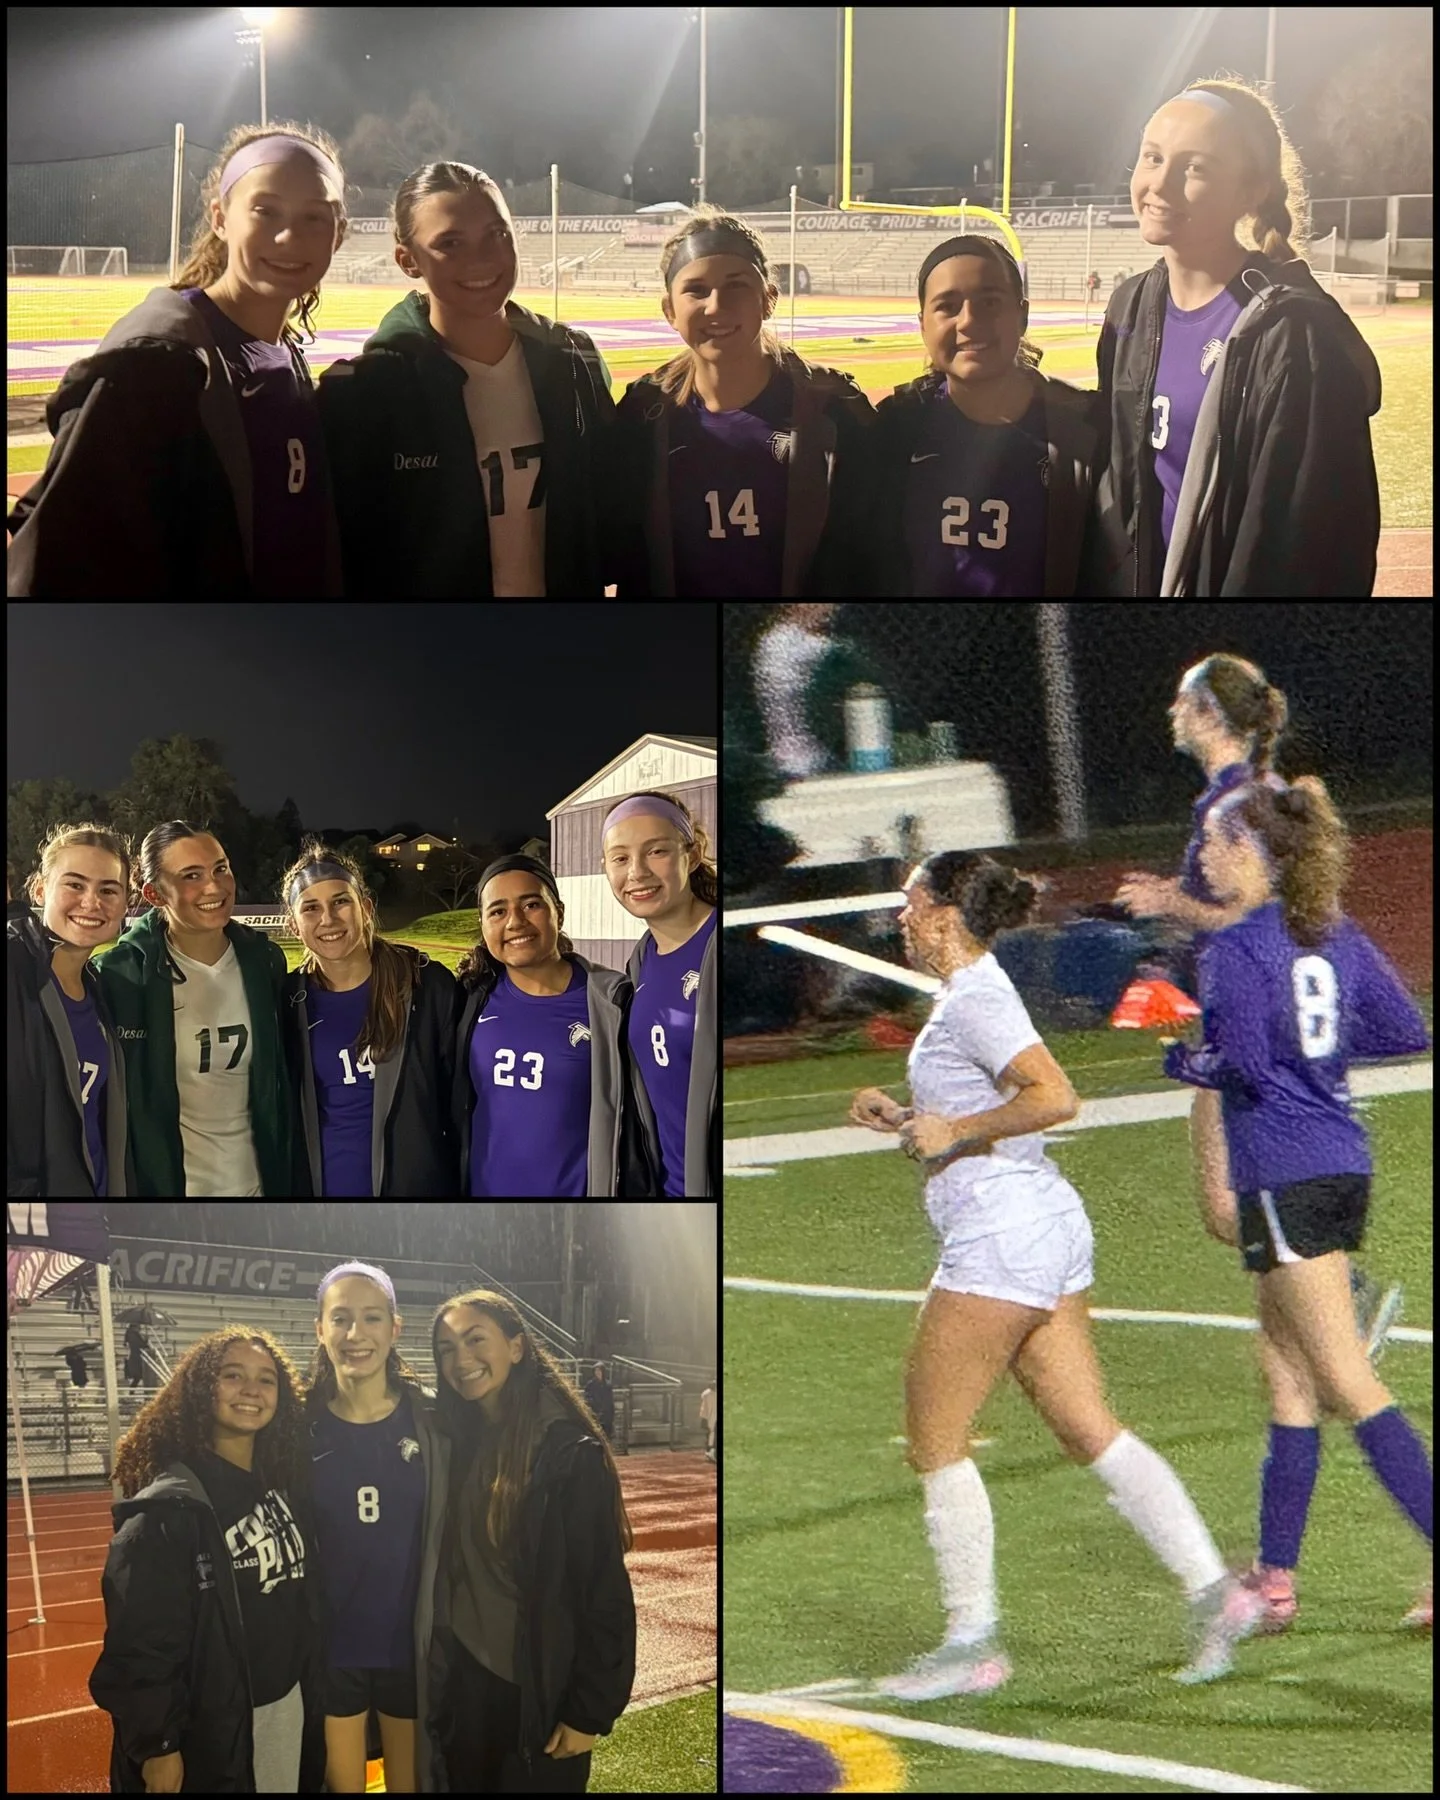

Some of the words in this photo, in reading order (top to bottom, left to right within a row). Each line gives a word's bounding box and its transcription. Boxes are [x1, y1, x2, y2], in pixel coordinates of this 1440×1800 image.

[360, 221, 396, 233] COLLE
[514, 219, 540, 232] OME
[558, 219, 581, 233] THE
[796, 215, 870, 230] COURAGE
[880, 214, 926, 229] PRIDE
[937, 215, 997, 228] HONO
[1015, 210, 1110, 227] SACRIFICE
[287, 437, 306, 494] 8
[393, 452, 439, 471] Desai
[480, 441, 547, 517] 17
[704, 488, 761, 539] 14
[941, 496, 1010, 550] 23
[244, 916, 286, 925] SACRI
[1291, 954, 1340, 1059] 8
[194, 1023, 249, 1074] 17
[338, 1044, 376, 1085] 14
[651, 1024, 669, 1067] 8
[78, 1060, 99, 1105] 7
[493, 1048, 545, 1091] 23
[110, 1248, 296, 1292] ACRIFICE
[357, 1486, 380, 1523] 8
[233, 1557, 259, 1569] CLASS
